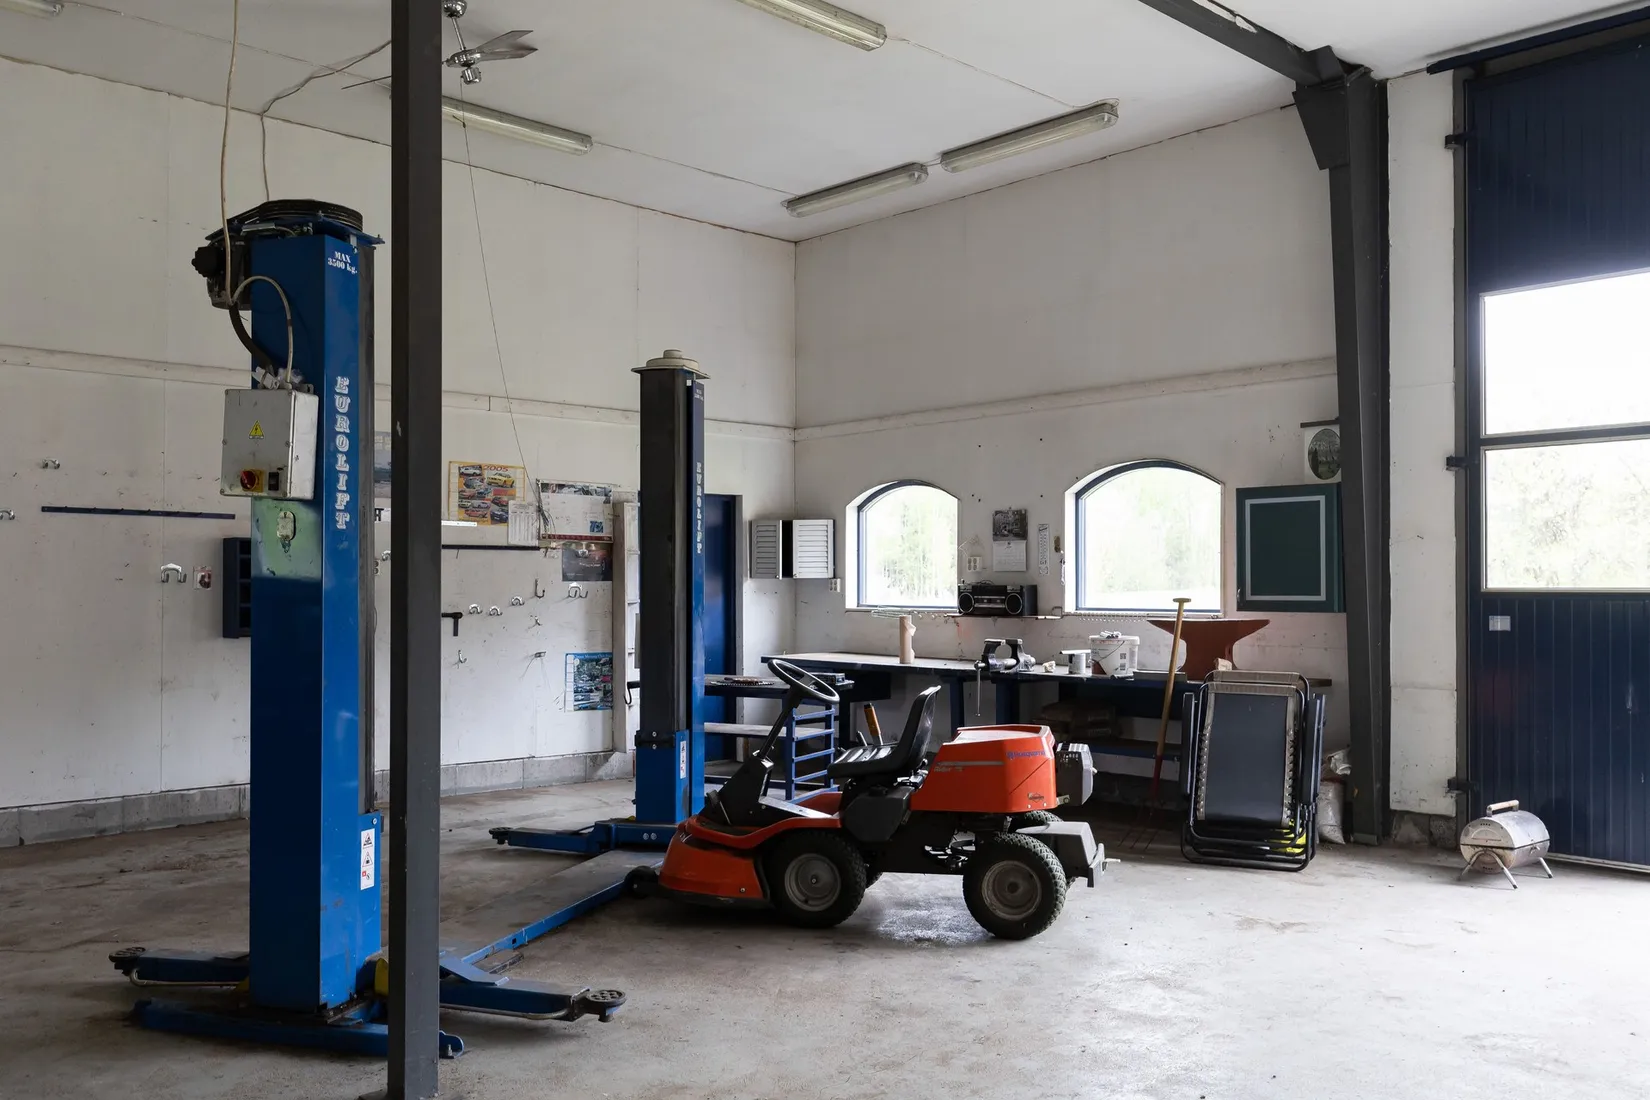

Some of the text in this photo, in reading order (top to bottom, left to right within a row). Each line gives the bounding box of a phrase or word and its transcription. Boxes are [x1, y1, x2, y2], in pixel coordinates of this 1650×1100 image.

[335, 251, 351, 263] MAX
[327, 257, 346, 270] 3500
[334, 376, 351, 530] EUROLIFT
[484, 464, 509, 472] 2005
